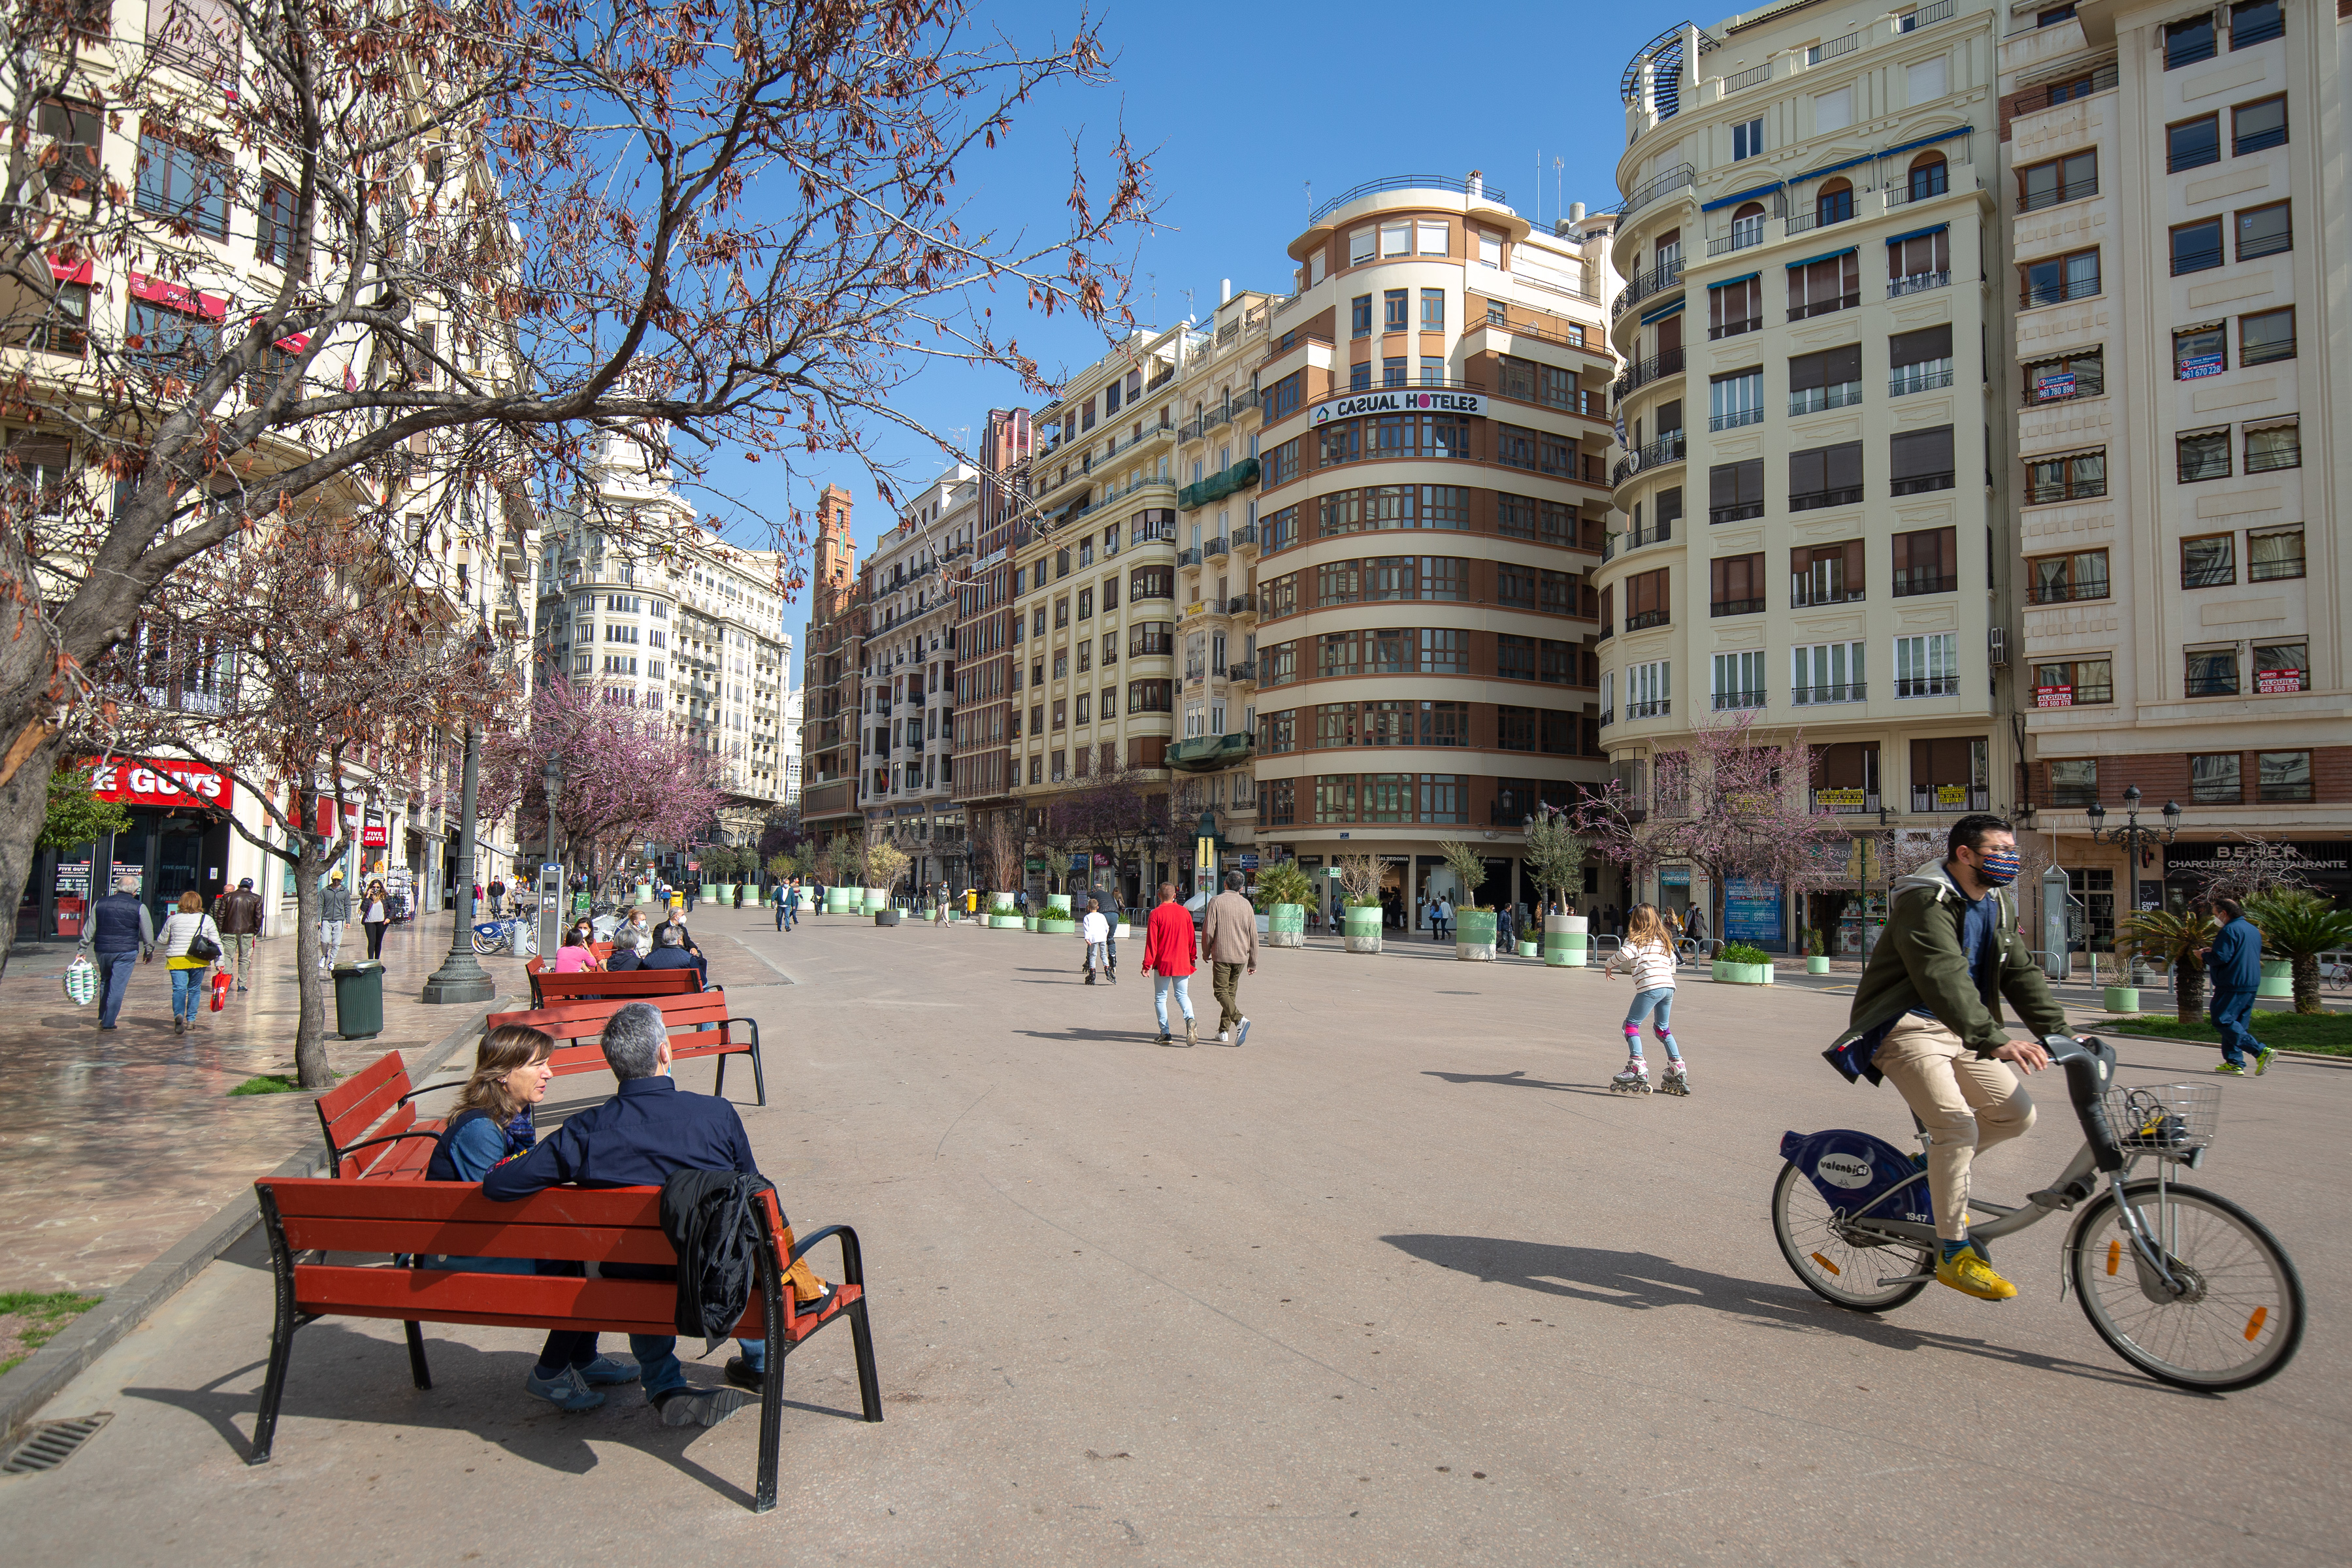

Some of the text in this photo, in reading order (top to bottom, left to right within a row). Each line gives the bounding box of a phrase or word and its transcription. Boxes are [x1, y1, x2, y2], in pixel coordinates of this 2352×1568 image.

[2182, 370, 2193, 379] 961
[2195, 367, 2207, 376] 670
[2208, 365, 2221, 374] 228
[2039, 389, 2049, 398] 961
[2051, 387, 2061, 395] 780
[2063, 385, 2074, 393] 898
[1337, 393, 1478, 416] CASUAL HOTELES
[129, 768, 222, 798] GUYS
[2217, 847, 2297, 858] BEHER
[1820, 1161, 1868, 1175] valenbisi
[1905, 1213, 1927, 1222] 1947
